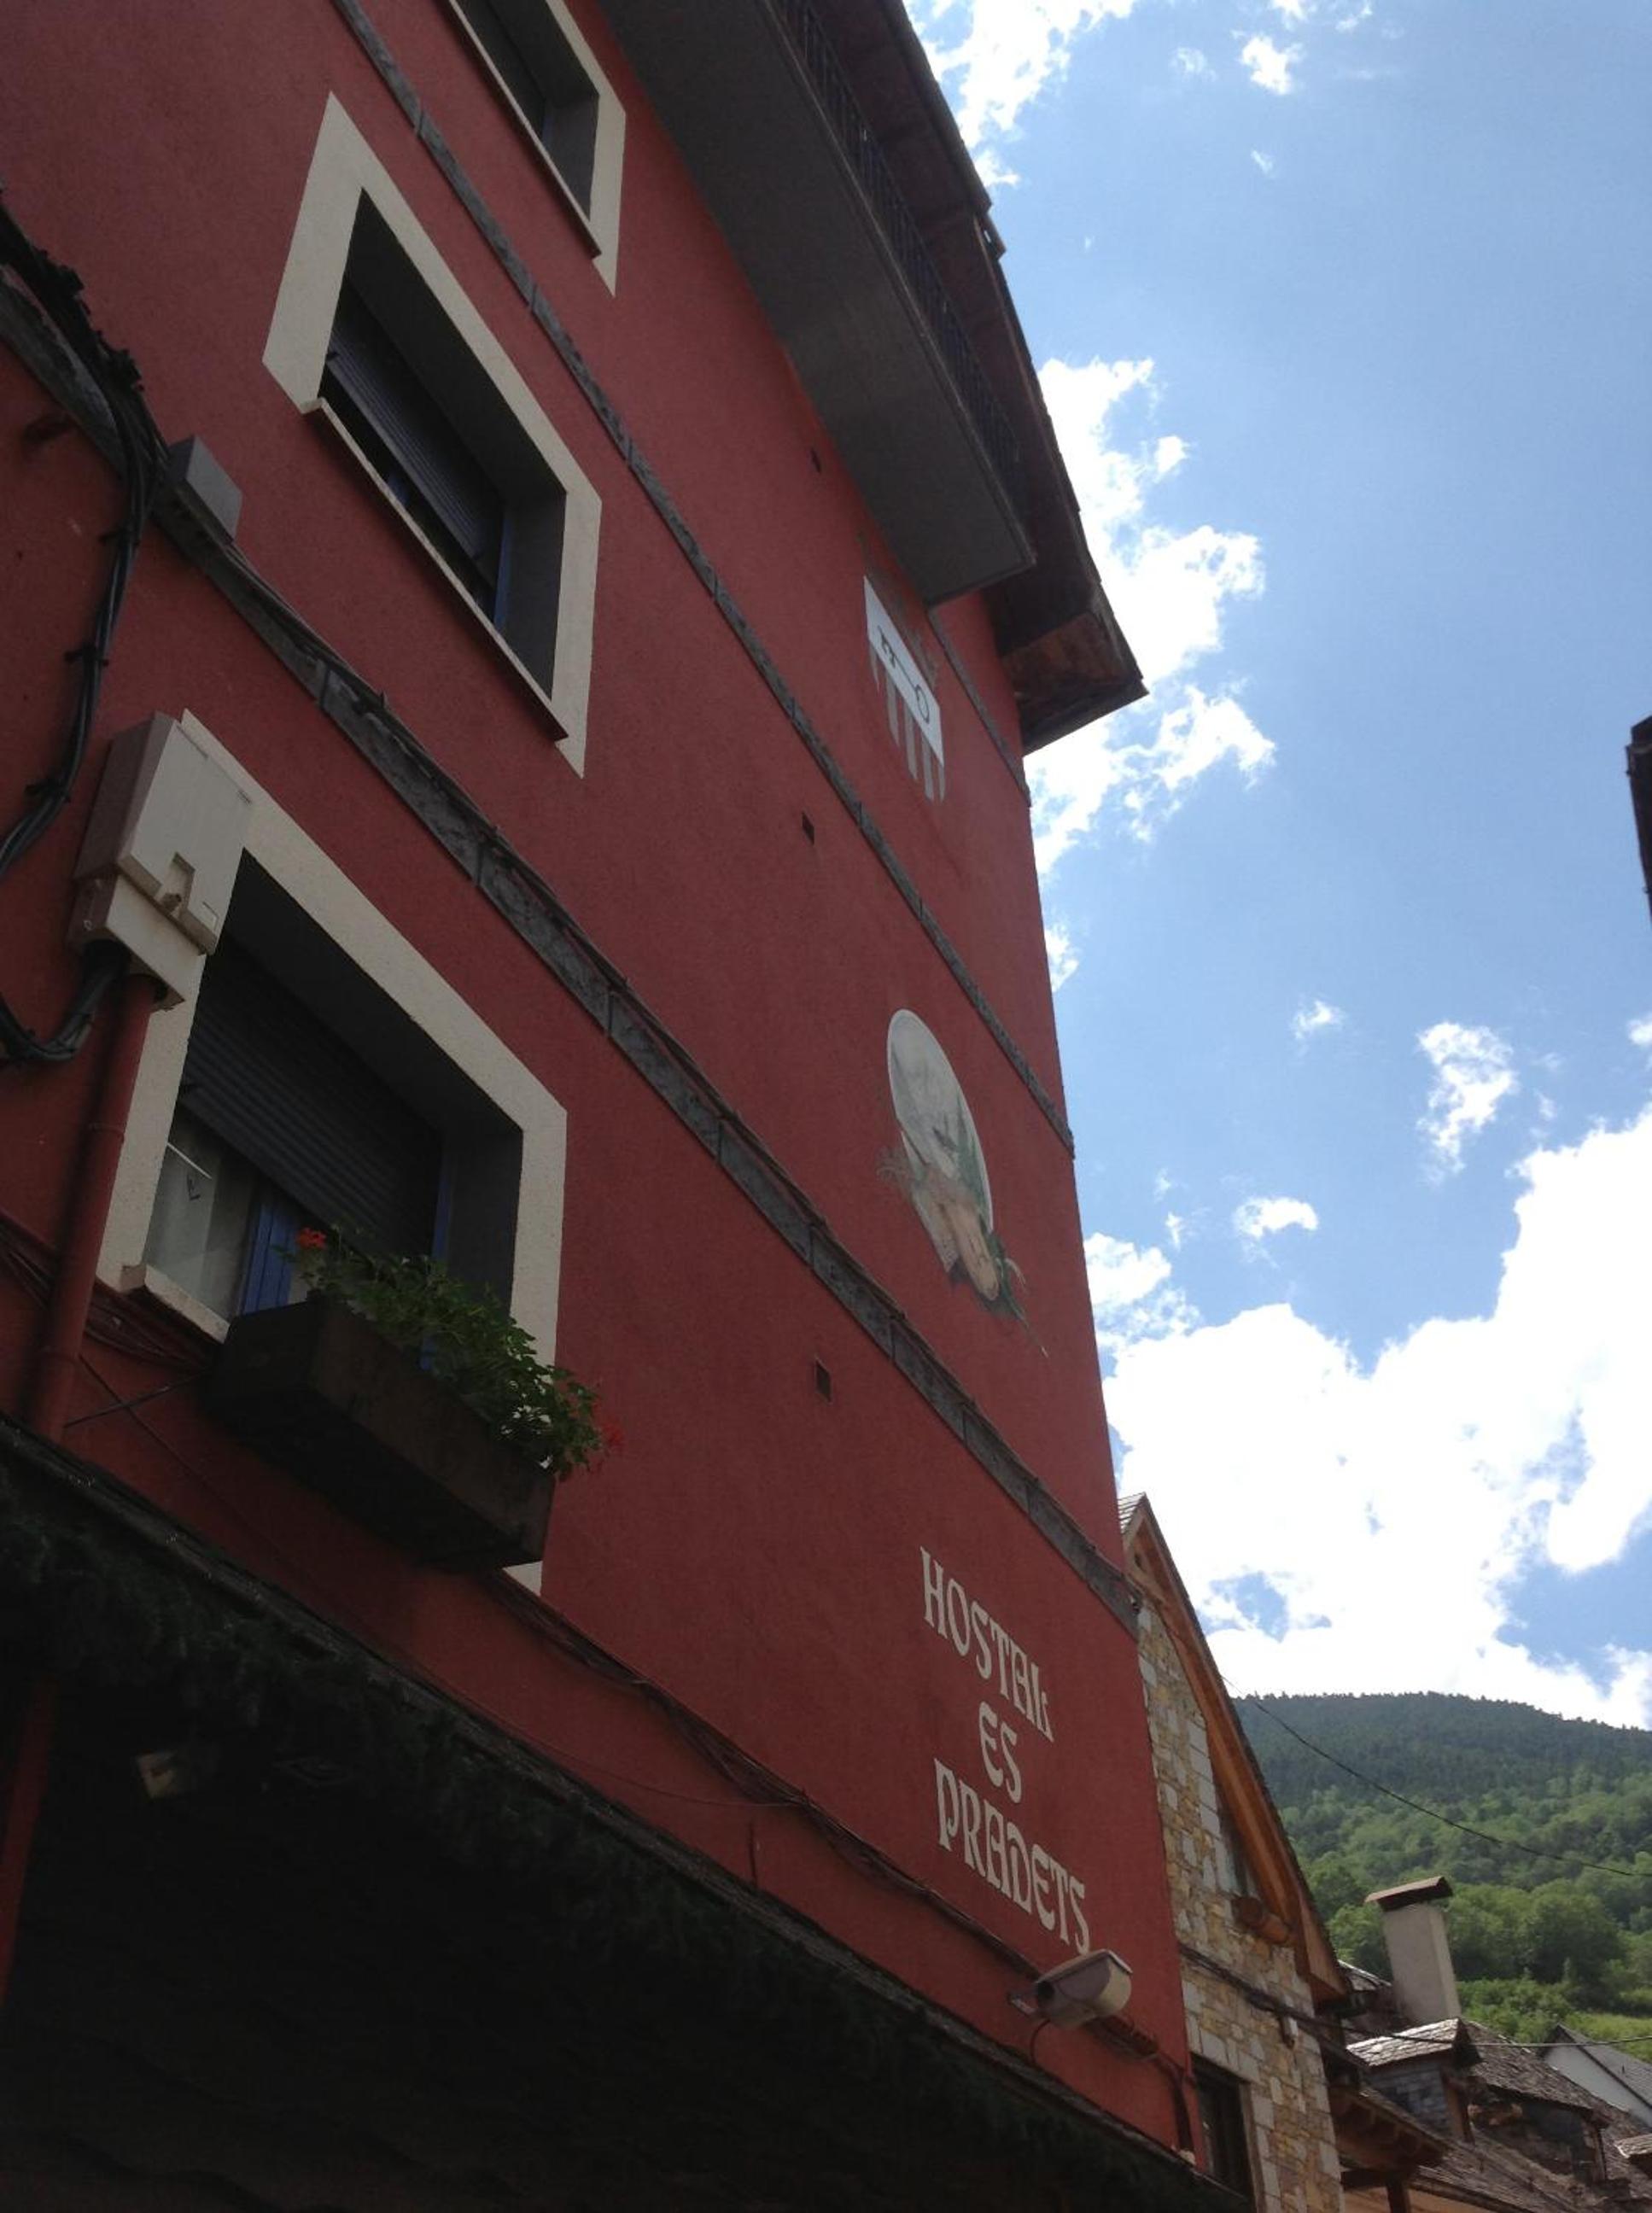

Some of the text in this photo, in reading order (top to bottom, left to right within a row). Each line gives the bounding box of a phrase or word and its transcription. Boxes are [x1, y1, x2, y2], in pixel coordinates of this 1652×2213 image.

[919, 1545, 1054, 1743] HOSTAL
[978, 1702, 1022, 1803] ES
[934, 1757, 1090, 1955] PRADETS
